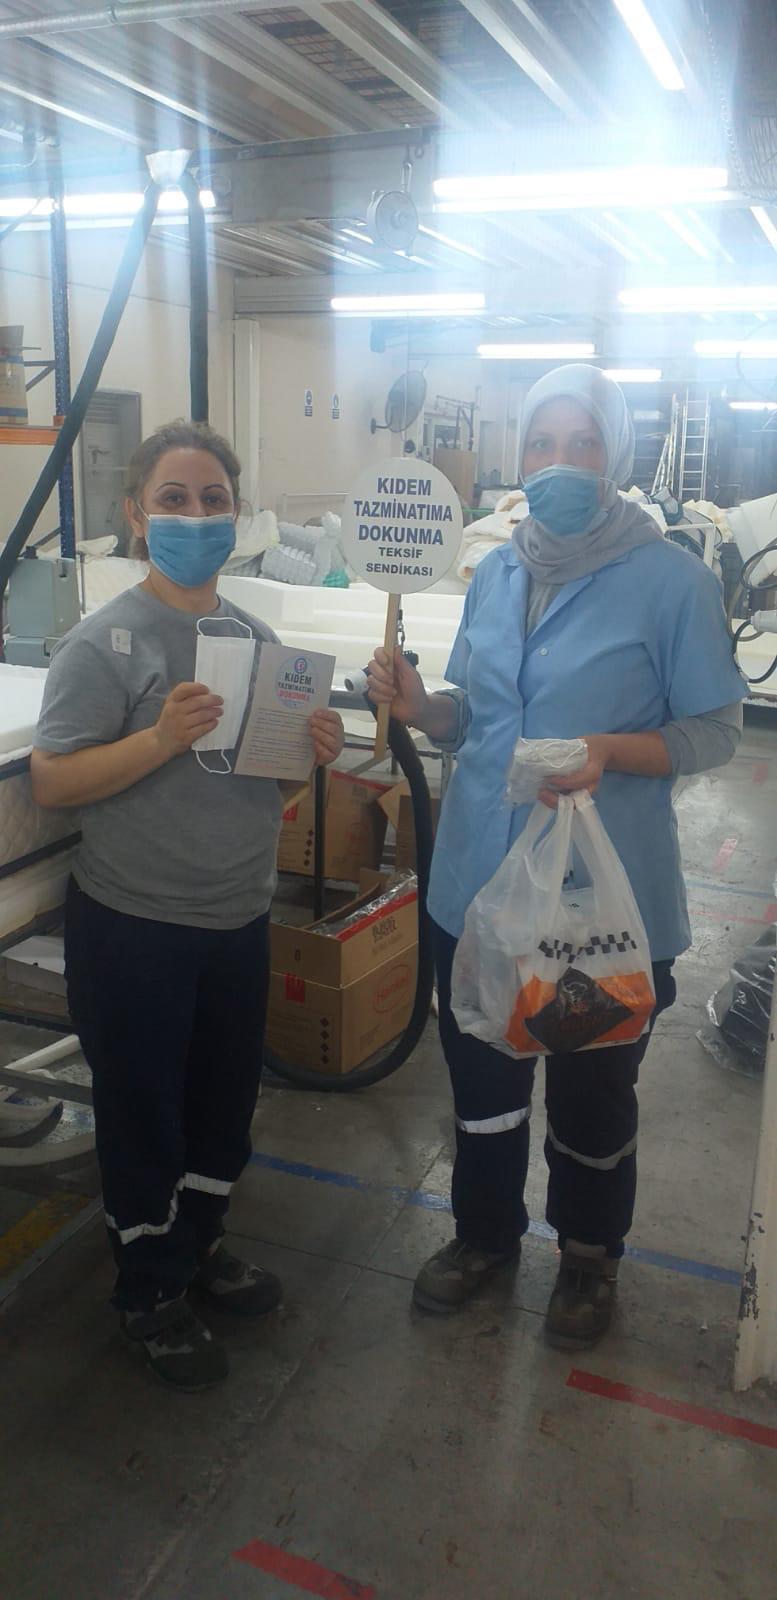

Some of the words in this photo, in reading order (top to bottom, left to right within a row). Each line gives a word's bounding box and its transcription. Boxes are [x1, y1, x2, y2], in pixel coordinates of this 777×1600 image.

[377, 477, 432, 496] KIDEM
[354, 498, 453, 522] TAZMİNATIMA
[358, 524, 444, 545] DOKUNMA
[378, 546, 423, 559] TEKSİF
[366, 562, 433, 577] SENDİKASI
[284, 671, 312, 686] KIDEM
